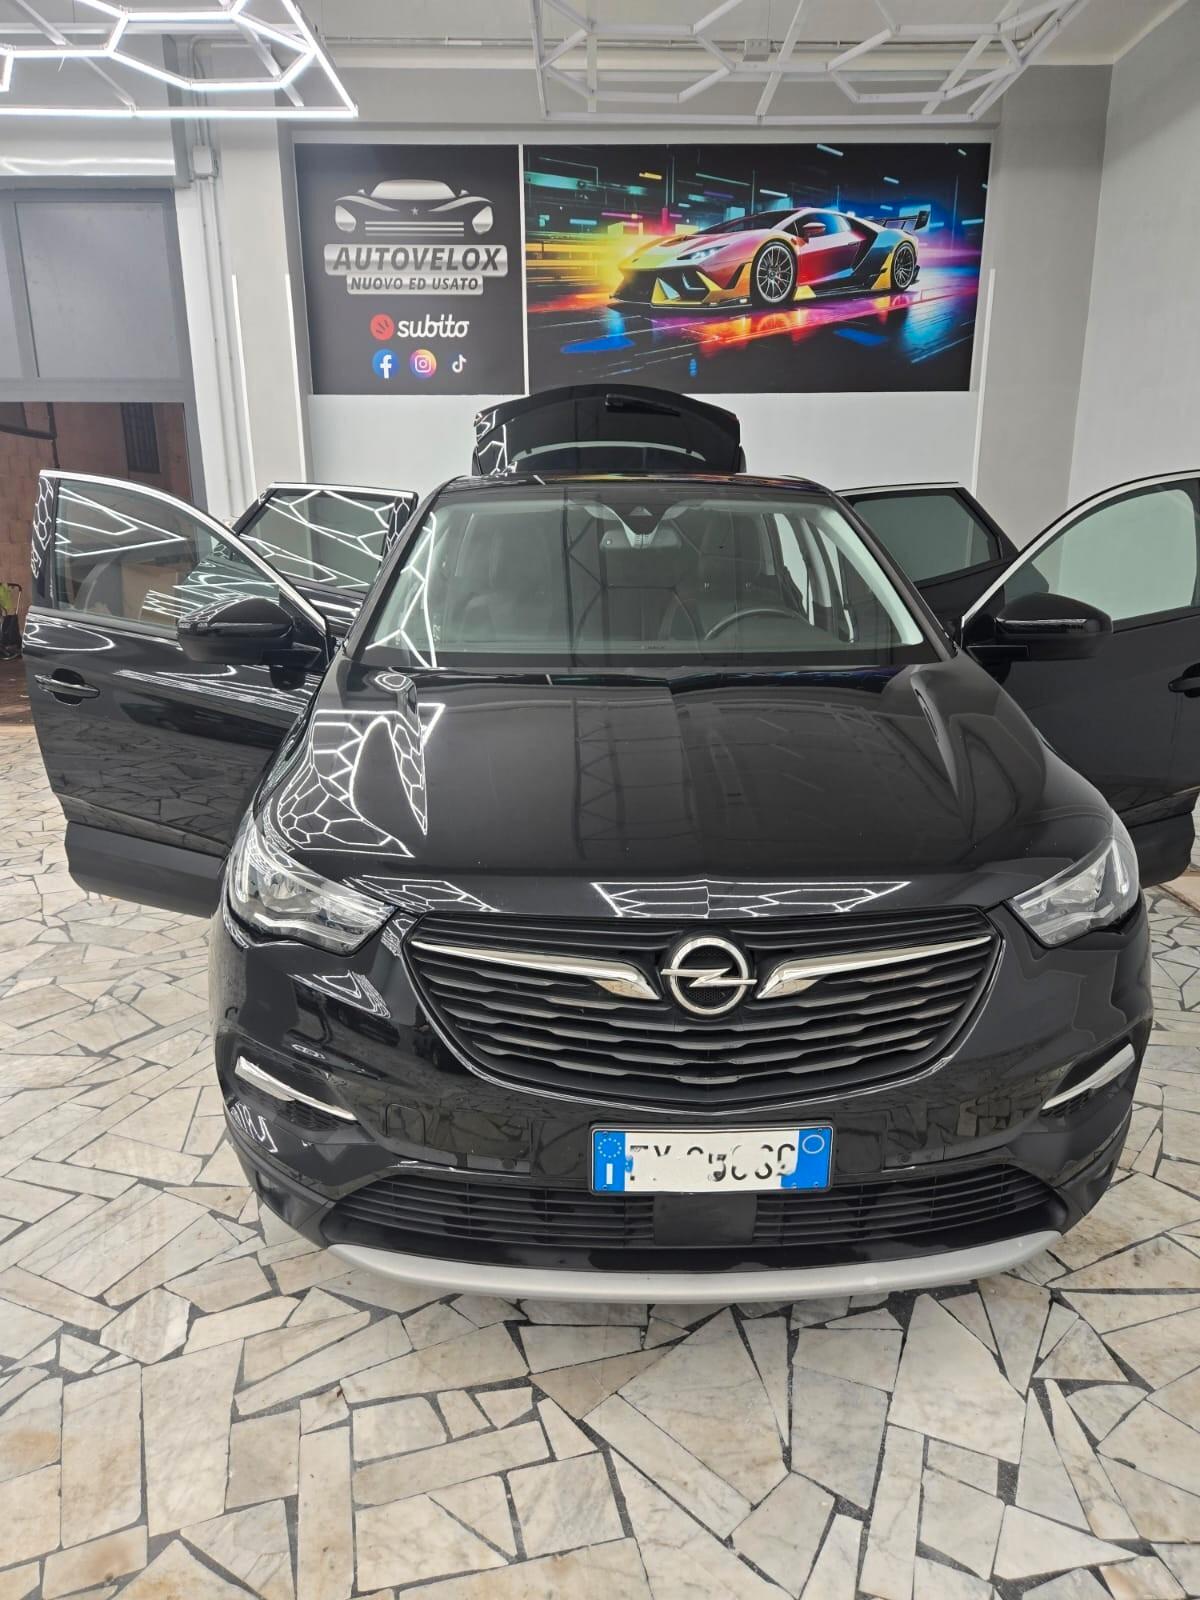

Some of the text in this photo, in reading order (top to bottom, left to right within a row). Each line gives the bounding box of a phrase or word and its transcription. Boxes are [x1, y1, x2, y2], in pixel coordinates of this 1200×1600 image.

[333, 246, 501, 271] AUTOVELOX
[350, 277, 478, 290] NUOVO ED USATO
[397, 314, 469, 338] subito
